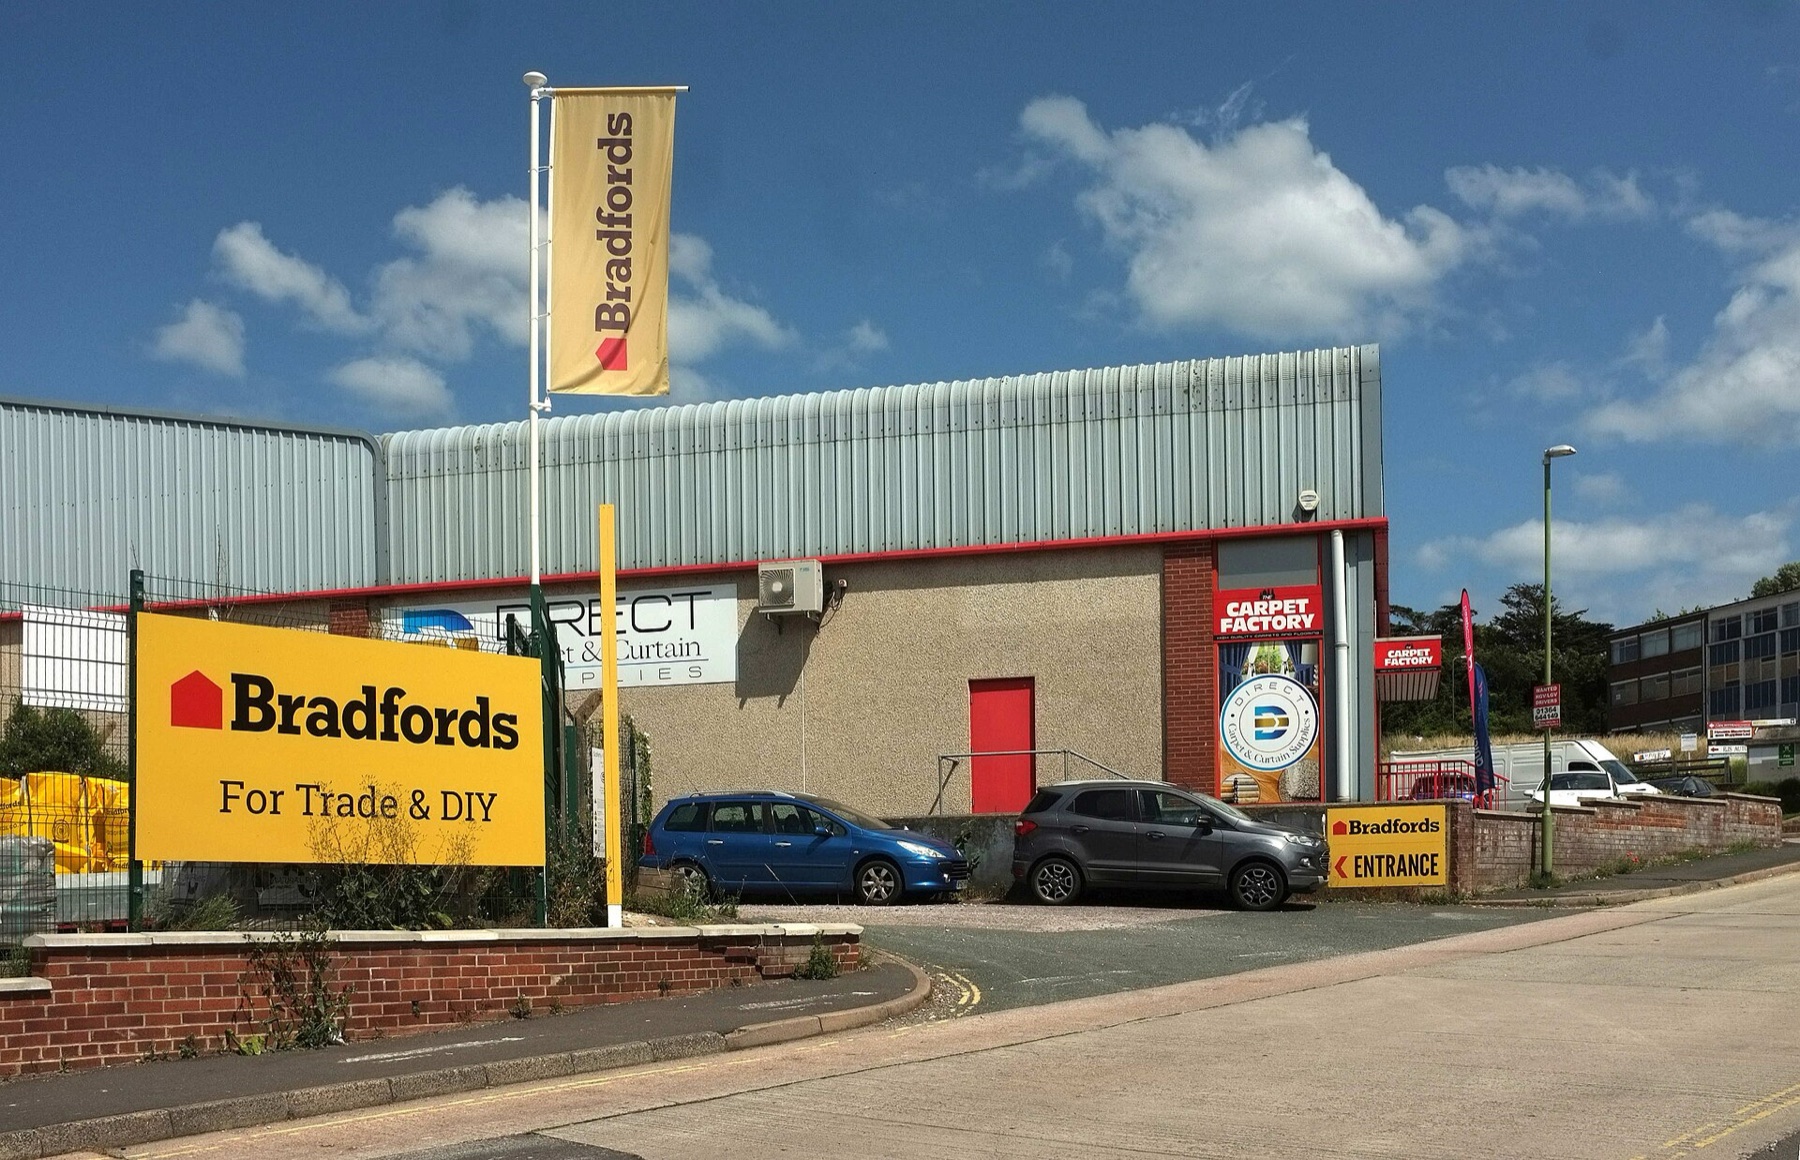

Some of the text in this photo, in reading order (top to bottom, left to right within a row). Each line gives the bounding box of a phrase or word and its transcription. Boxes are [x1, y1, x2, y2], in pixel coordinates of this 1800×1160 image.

[595, 111, 633, 334] Bradfords
[496, 591, 712, 641] DRECT
[1226, 598, 1309, 617] CARPET
[1220, 613, 1315, 633] FACTORY
[1384, 656, 1434, 667] FACTORY
[1387, 648, 1431, 658] CARPET
[1234, 681, 1305, 707] DIRECT
[1535, 698, 1558, 706] DRIVERS
[230, 672, 520, 750] Bradfords
[1228, 717, 1311, 764] Carpet & Curtain Supplies
[219, 780, 498, 823] For Trade & DIY
[1349, 818, 1439, 835] Bradfords
[1354, 853, 1438, 877] ENTRANCE
